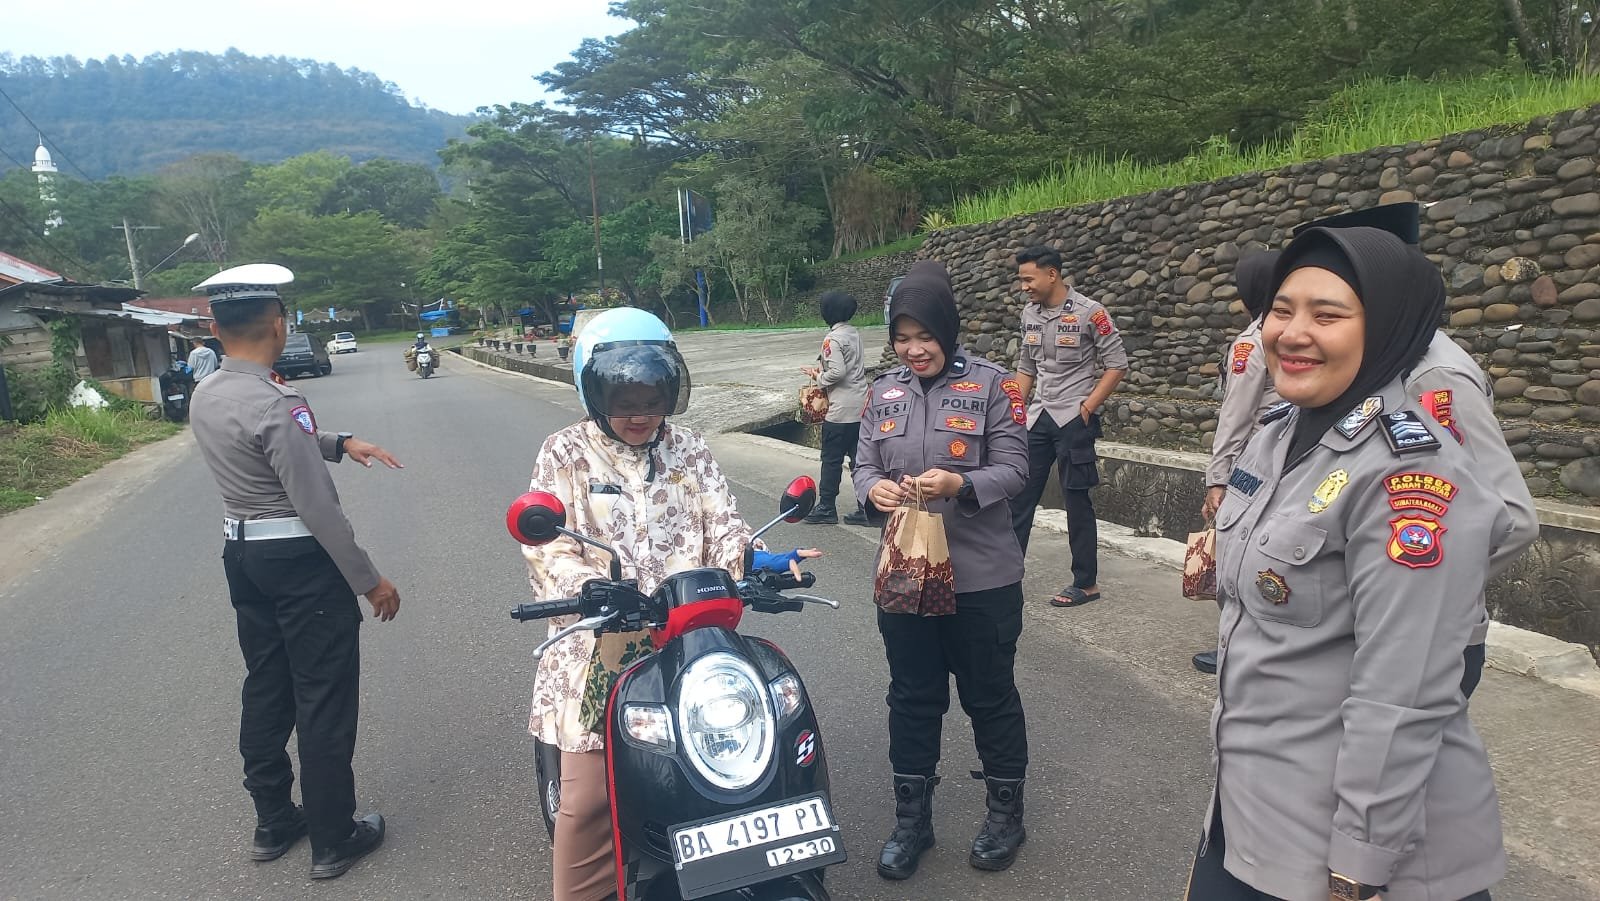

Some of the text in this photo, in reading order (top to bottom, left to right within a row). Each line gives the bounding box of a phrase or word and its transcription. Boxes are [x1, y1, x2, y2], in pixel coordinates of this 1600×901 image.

[1057, 325, 1080, 333] POLRI
[876, 403, 907, 418] YESI
[941, 398, 985, 415] POLRI
[1396, 435, 1434, 447] POLISI
[1390, 475, 1452, 491] POLRES
[1390, 482, 1450, 498] TANAH DATAR
[697, 585, 727, 594] HONDA
[679, 803, 823, 859] BA 4197 PI
